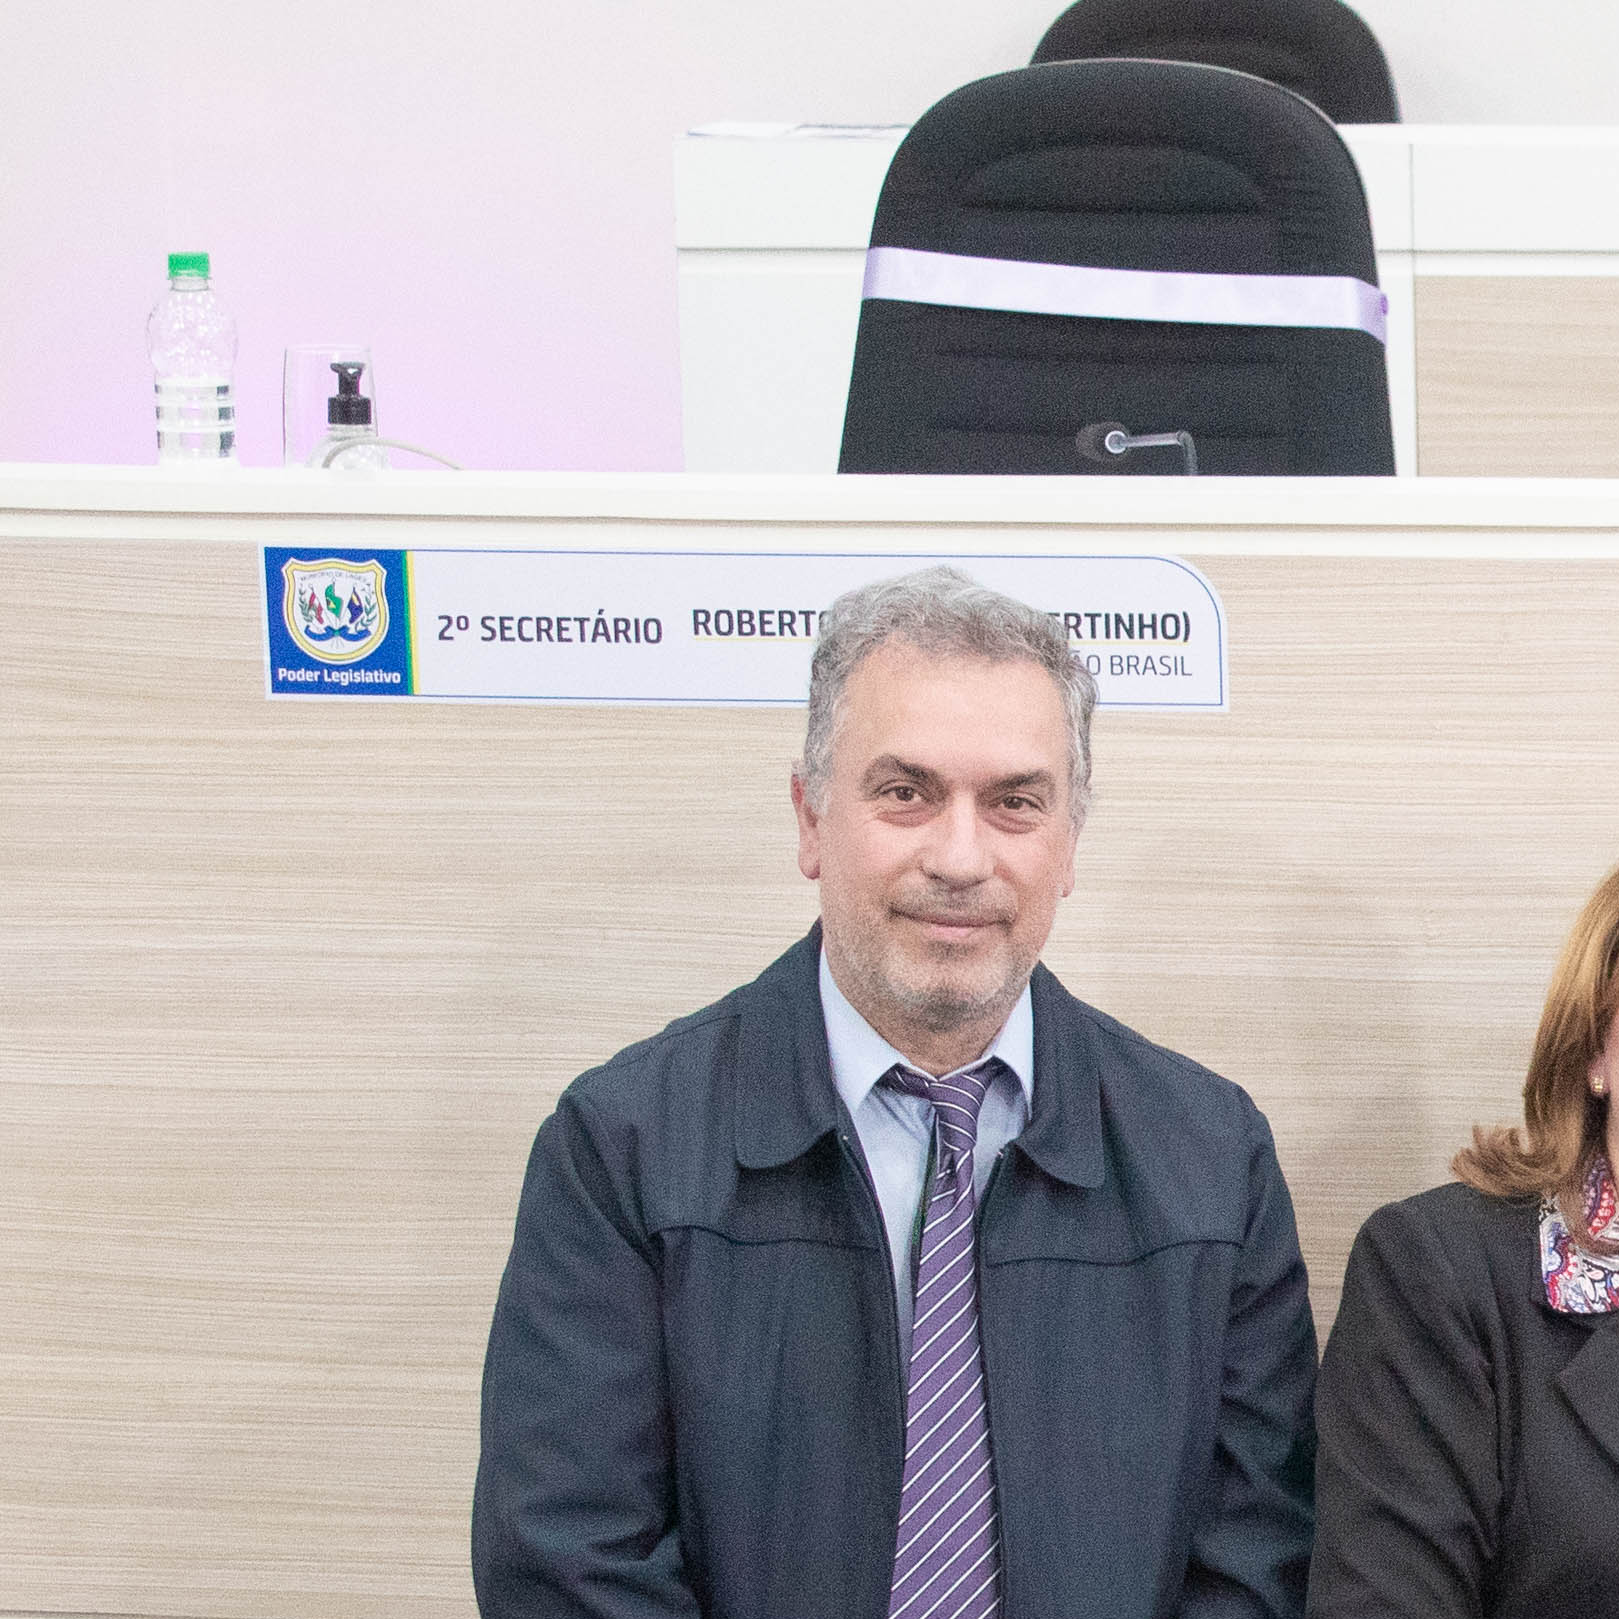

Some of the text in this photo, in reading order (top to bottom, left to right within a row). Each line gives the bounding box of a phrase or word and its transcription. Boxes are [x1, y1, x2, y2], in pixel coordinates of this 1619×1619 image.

[480, 609, 663, 644] SECRETÁRIO
[1047, 611, 1191, 643] RTINHO)
[277, 667, 401, 686] Poder Legislativo
[1110, 654, 1193, 677] BRASIL
